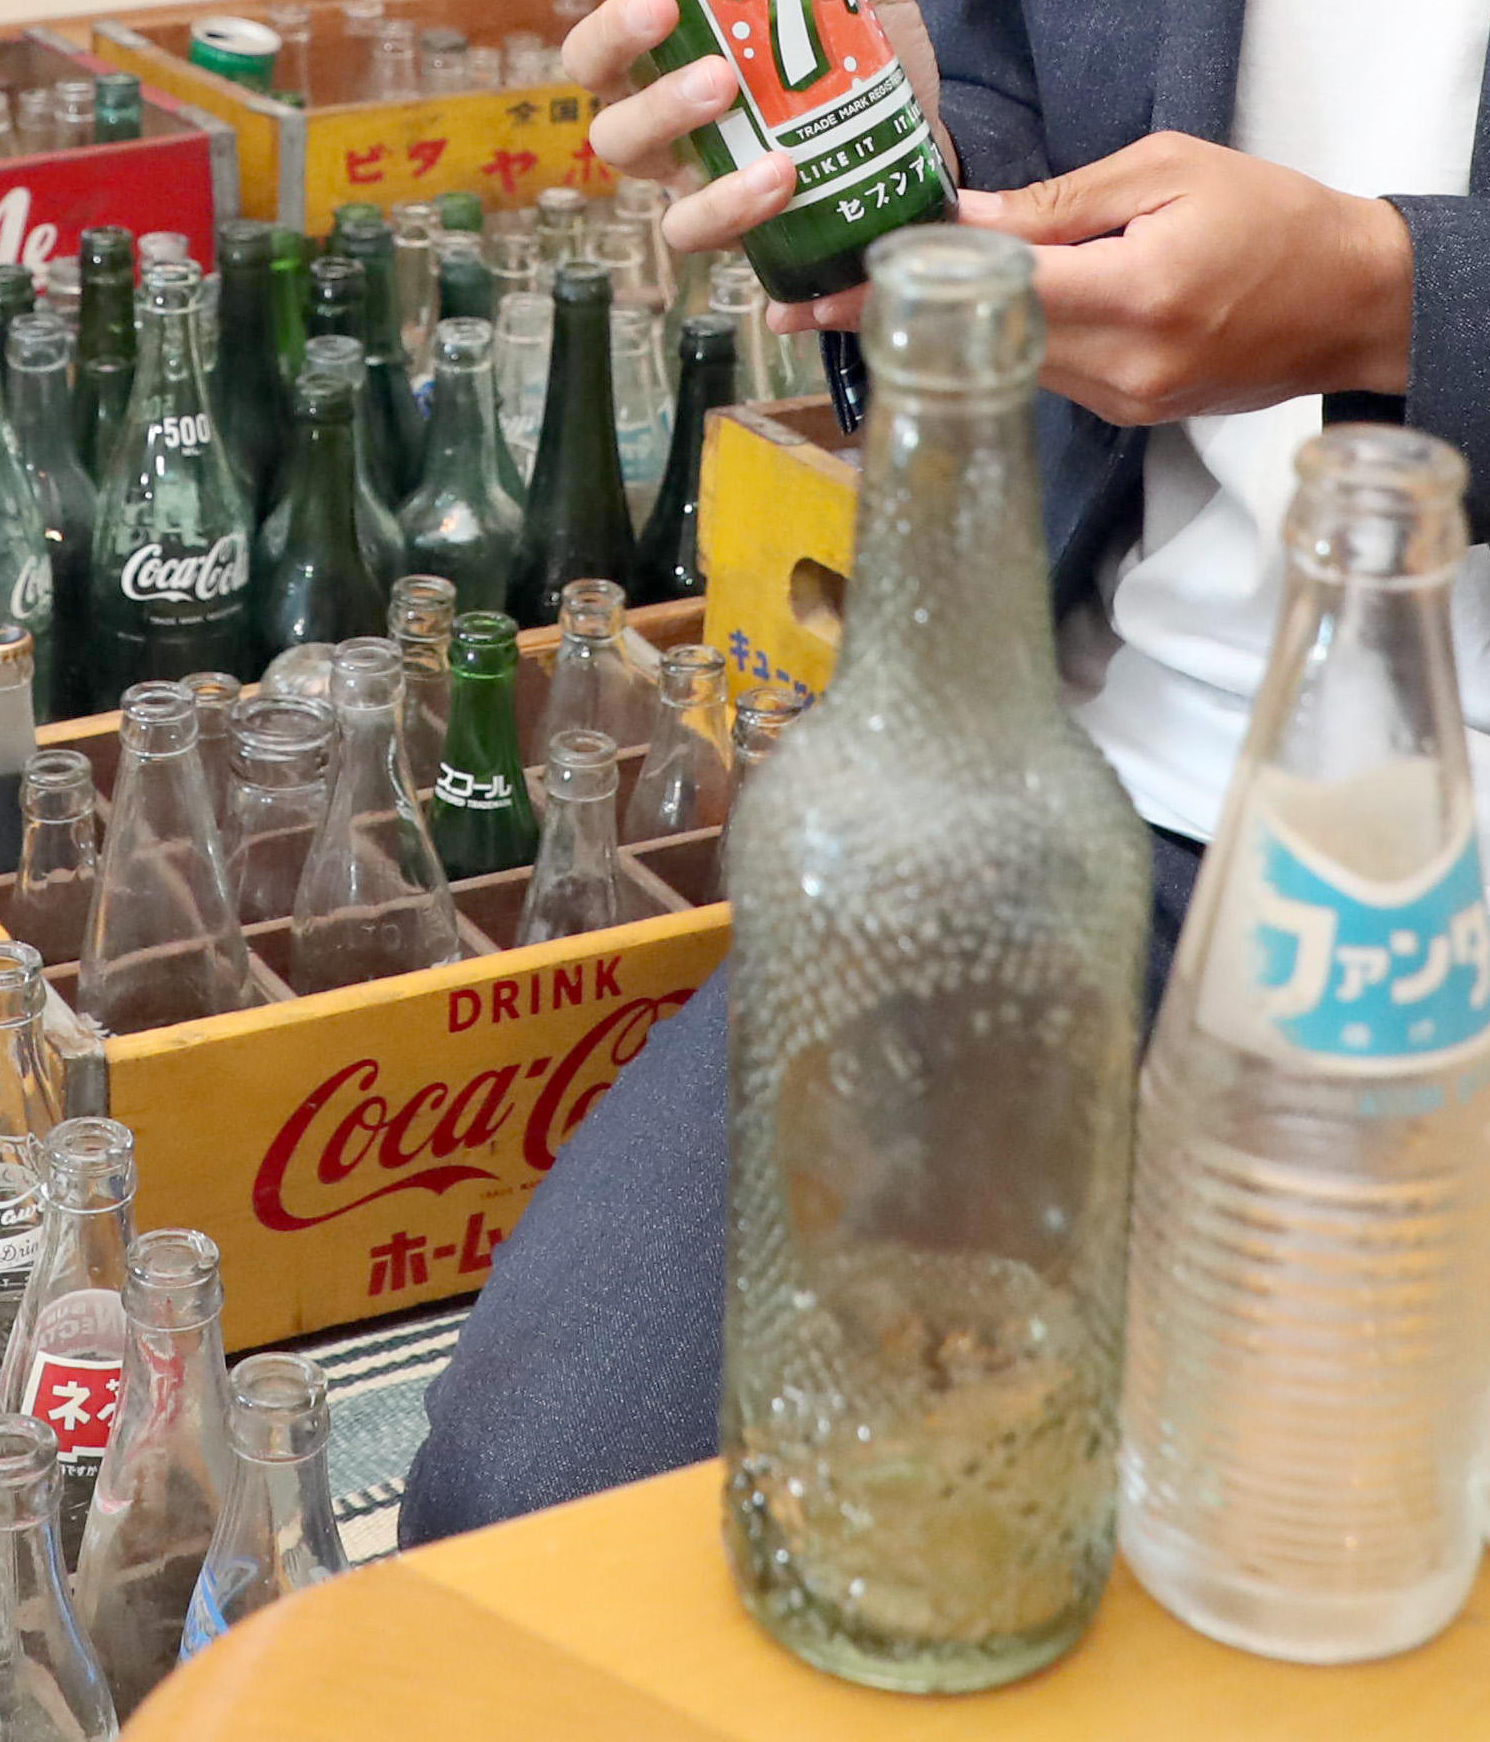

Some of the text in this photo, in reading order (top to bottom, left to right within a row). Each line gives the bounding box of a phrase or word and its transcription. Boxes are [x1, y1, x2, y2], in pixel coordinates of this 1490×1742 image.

[796, 115, 838, 140] TRADE
[839, 98, 870, 121] MARK
[799, 151, 850, 184] LIKE
[855, 136, 875, 157] IT
[894, 115, 907, 134] IT
[163, 413, 212, 448] 500
[448, 955, 623, 1034] DRINK
